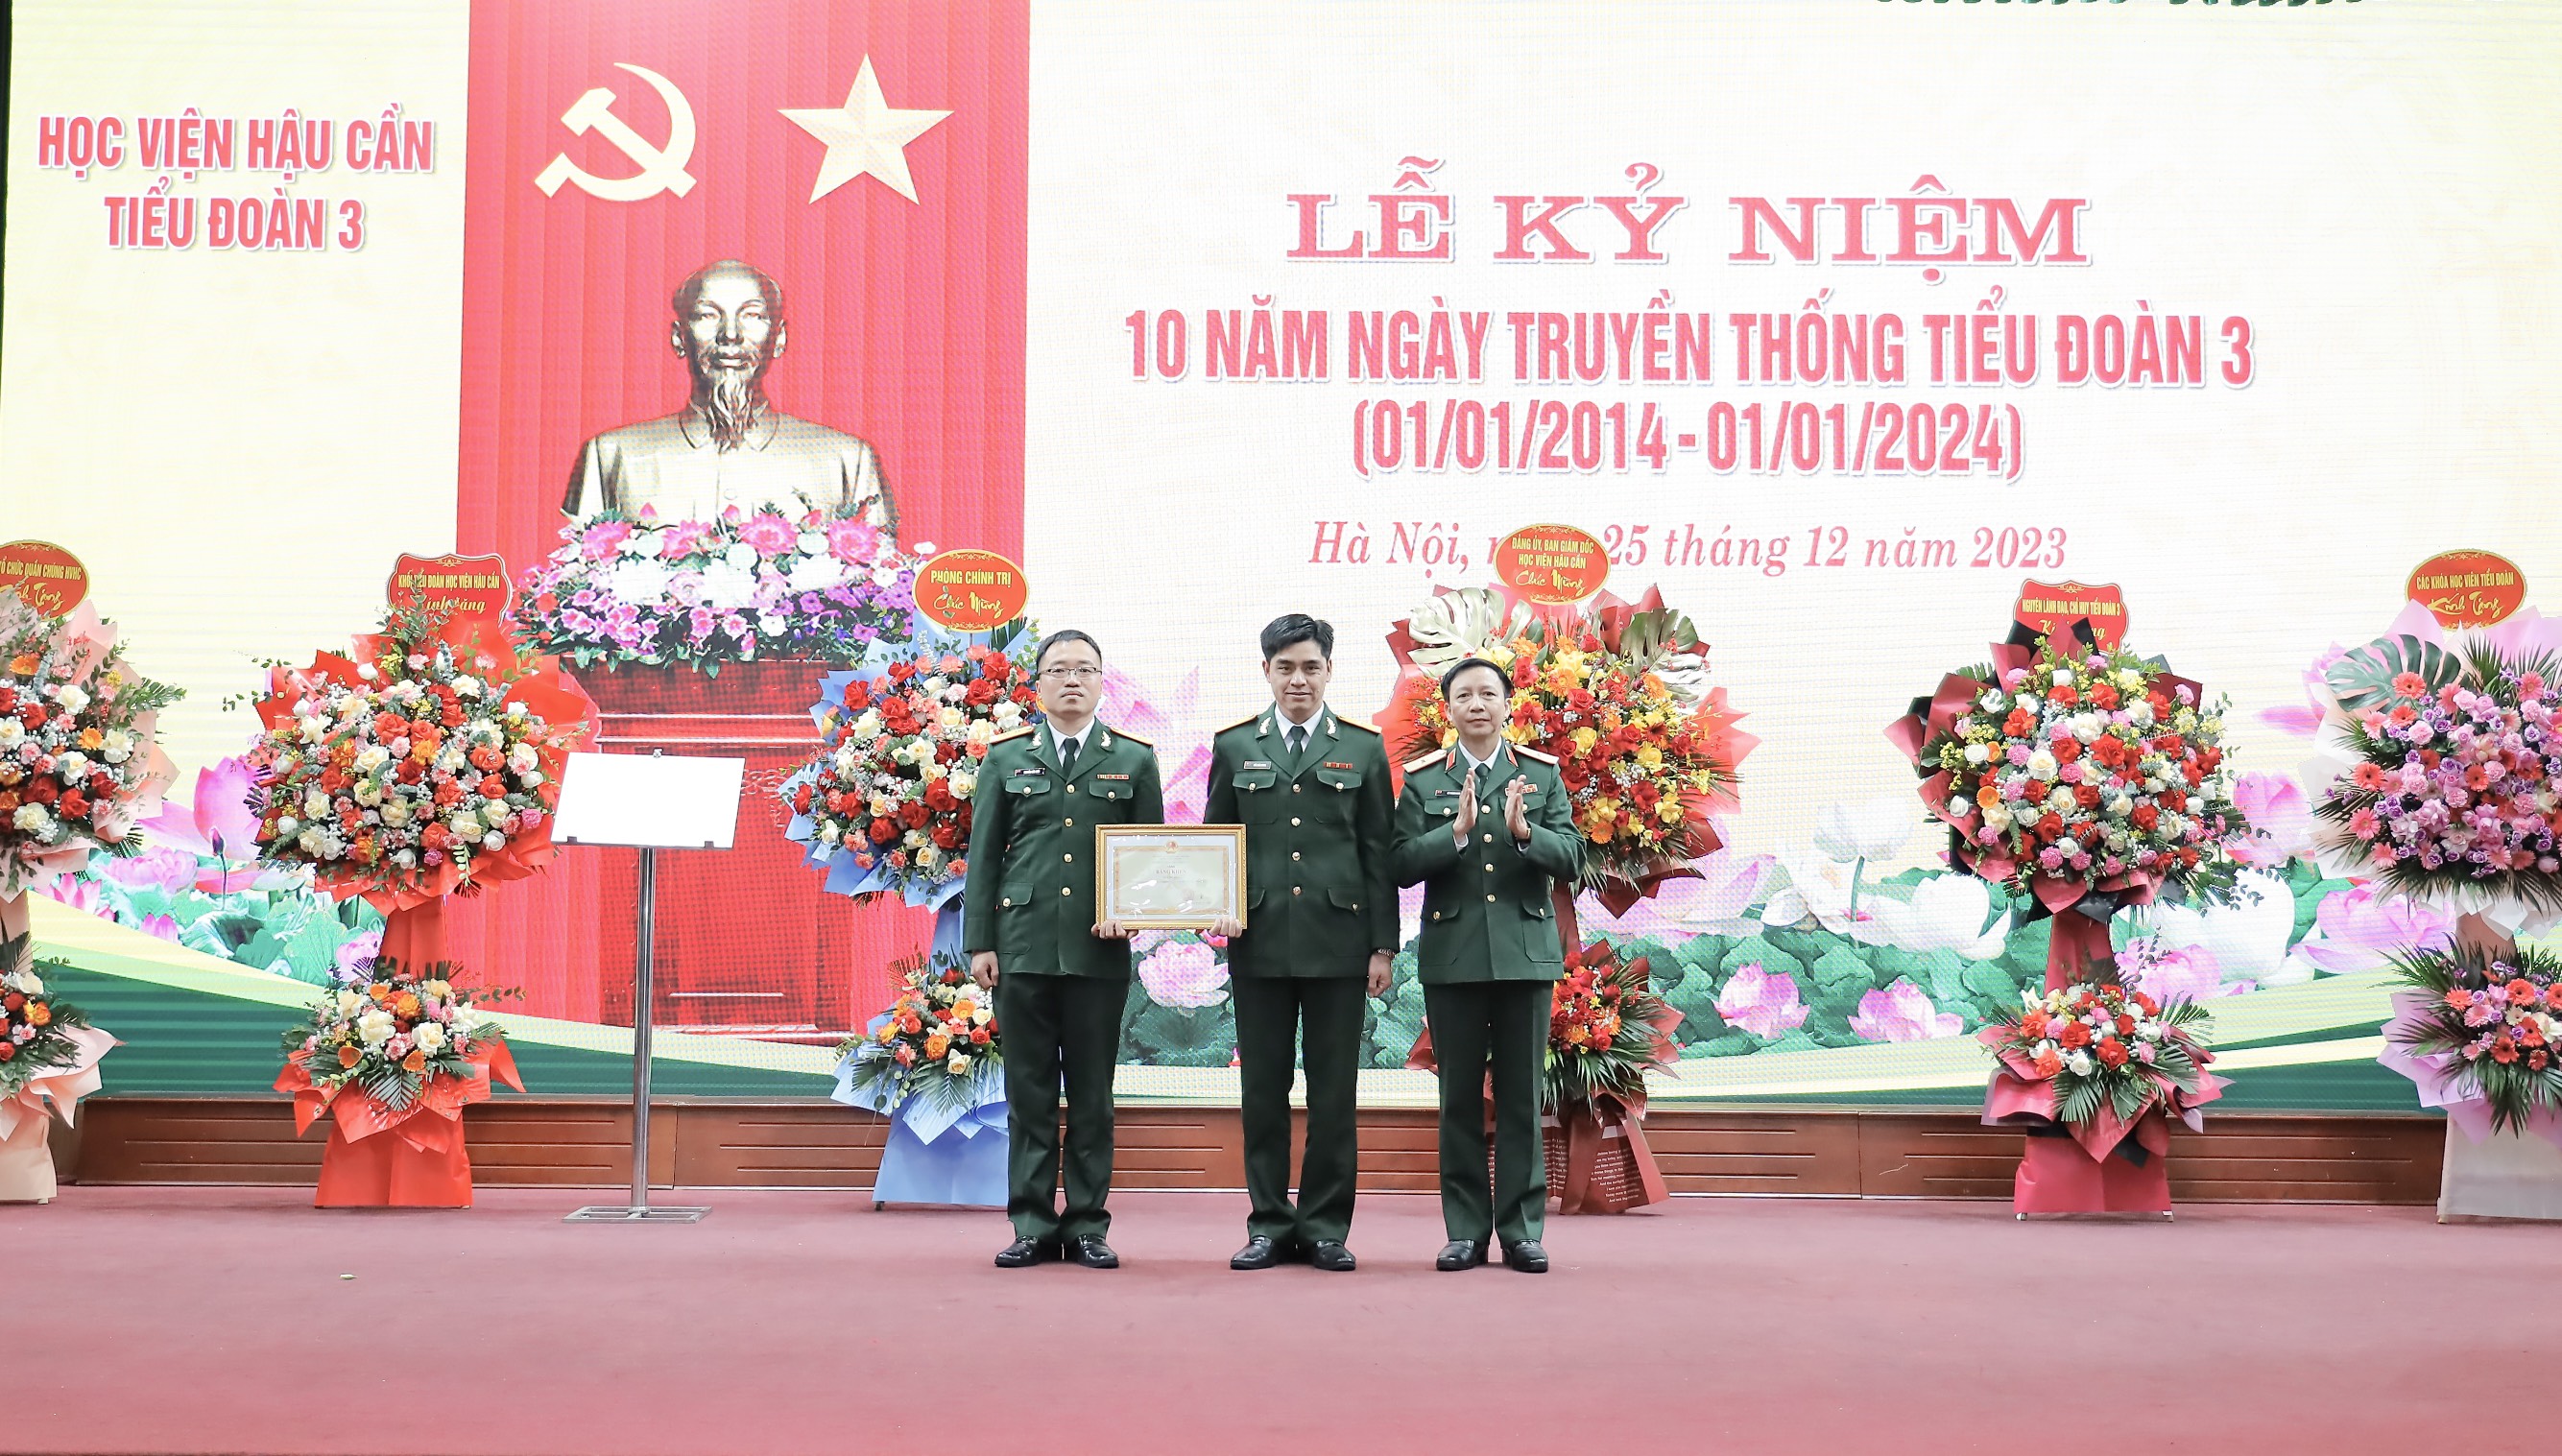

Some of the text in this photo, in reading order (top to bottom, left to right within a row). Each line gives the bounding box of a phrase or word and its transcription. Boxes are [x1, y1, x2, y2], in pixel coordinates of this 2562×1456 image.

[39, 102, 434, 181] HỌC VIỆN HẬU CẦN
[104, 176, 365, 251] TIỂU ĐOÀN 3
[1285, 155, 2093, 285] LỄ KỶ NIỆM
[1124, 284, 2256, 389] 10 NĂM NGÀY TRUYỀN THỐNG TIỂU ĐOÀN 3
[1308, 521, 1371, 564] Hà
[1388, 521, 1469, 579] Nội,
[1603, 523, 1648, 565] 25
[1664, 522, 1788, 577] tháng
[1803, 525, 1849, 567] 12
[1863, 525, 1958, 568] năm
[1969, 526, 2069, 568] 2023
[1512, 534, 1531, 550] ĐẢNG
[1544, 539, 1559, 552] BAN
[1561, 538, 1578, 553] GIÁM
[1580, 537, 1594, 554] ĐỐC
[1519, 554, 1533, 567] HỌC
[1535, 553, 1552, 569] VIỆN
[1553, 554, 1568, 570] HẬU
[930, 567, 1012, 588] PHÒNG CHÍNH TRỊ
[1516, 569, 1546, 585] Chúc
